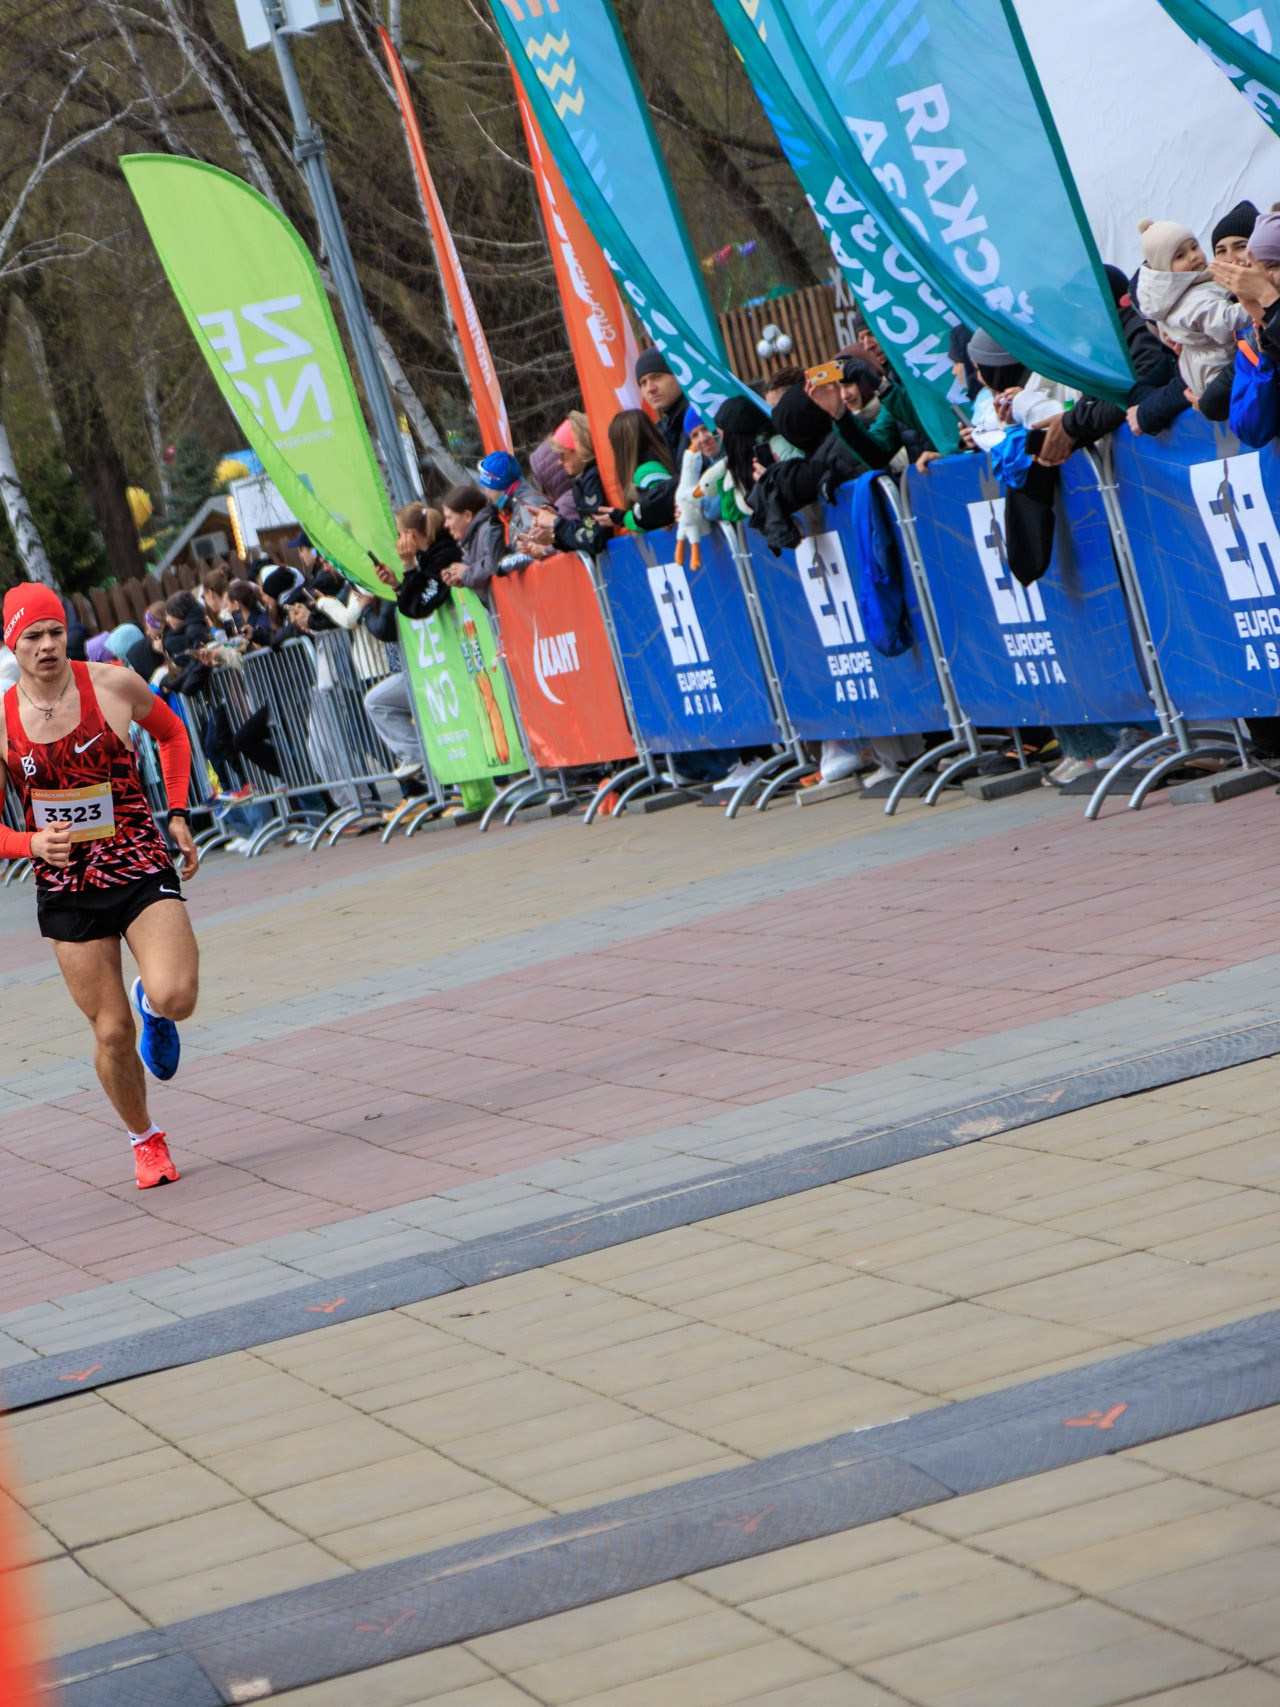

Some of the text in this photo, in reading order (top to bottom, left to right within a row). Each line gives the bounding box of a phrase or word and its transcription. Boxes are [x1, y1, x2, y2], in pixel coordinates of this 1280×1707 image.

[1233, 608, 1280, 639] EURO
[539, 631, 580, 678] КАНТ
[1003, 631, 1056, 657] EUROPE
[827, 651, 873, 677] EUROPE
[1014, 660, 1067, 686] ASIA
[676, 668, 718, 693] EUROPE
[835, 677, 880, 702] ASIA
[683, 692, 723, 716] ASIA
[44, 803, 102, 823] 3323
